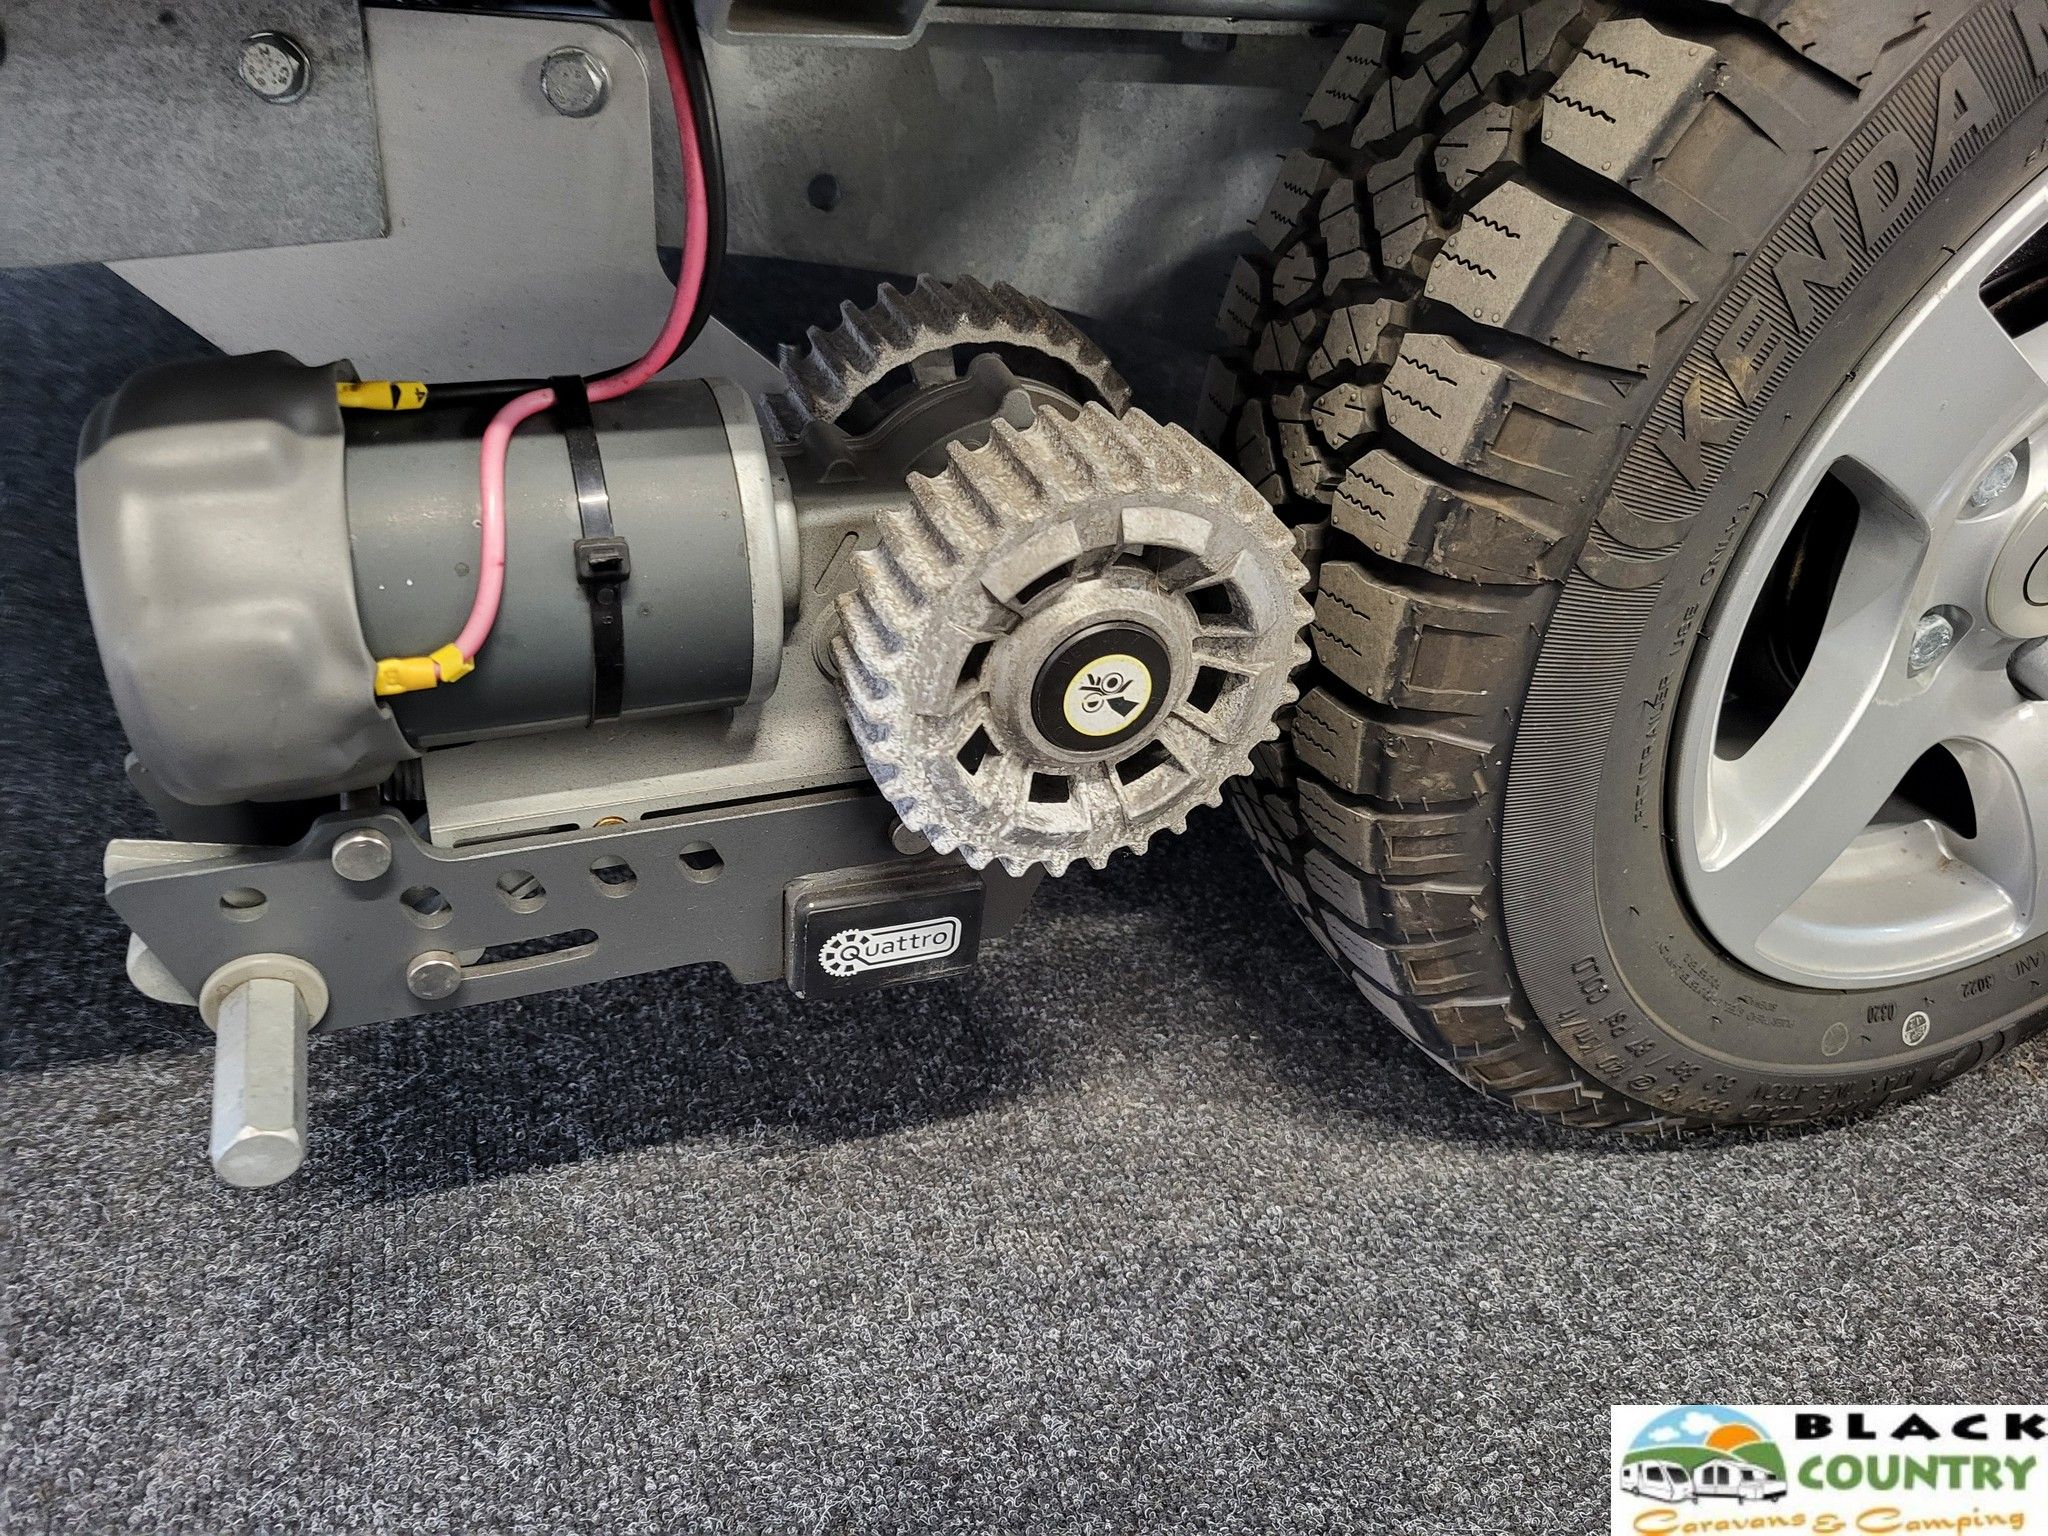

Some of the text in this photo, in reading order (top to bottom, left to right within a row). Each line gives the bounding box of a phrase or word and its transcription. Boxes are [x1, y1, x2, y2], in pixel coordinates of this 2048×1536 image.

[1654, 59, 2001, 491] KENDA
[840, 931, 948, 964] Quattro
[1961, 974, 1993, 998] 3022
[1866, 1002, 1895, 1024] 0320
